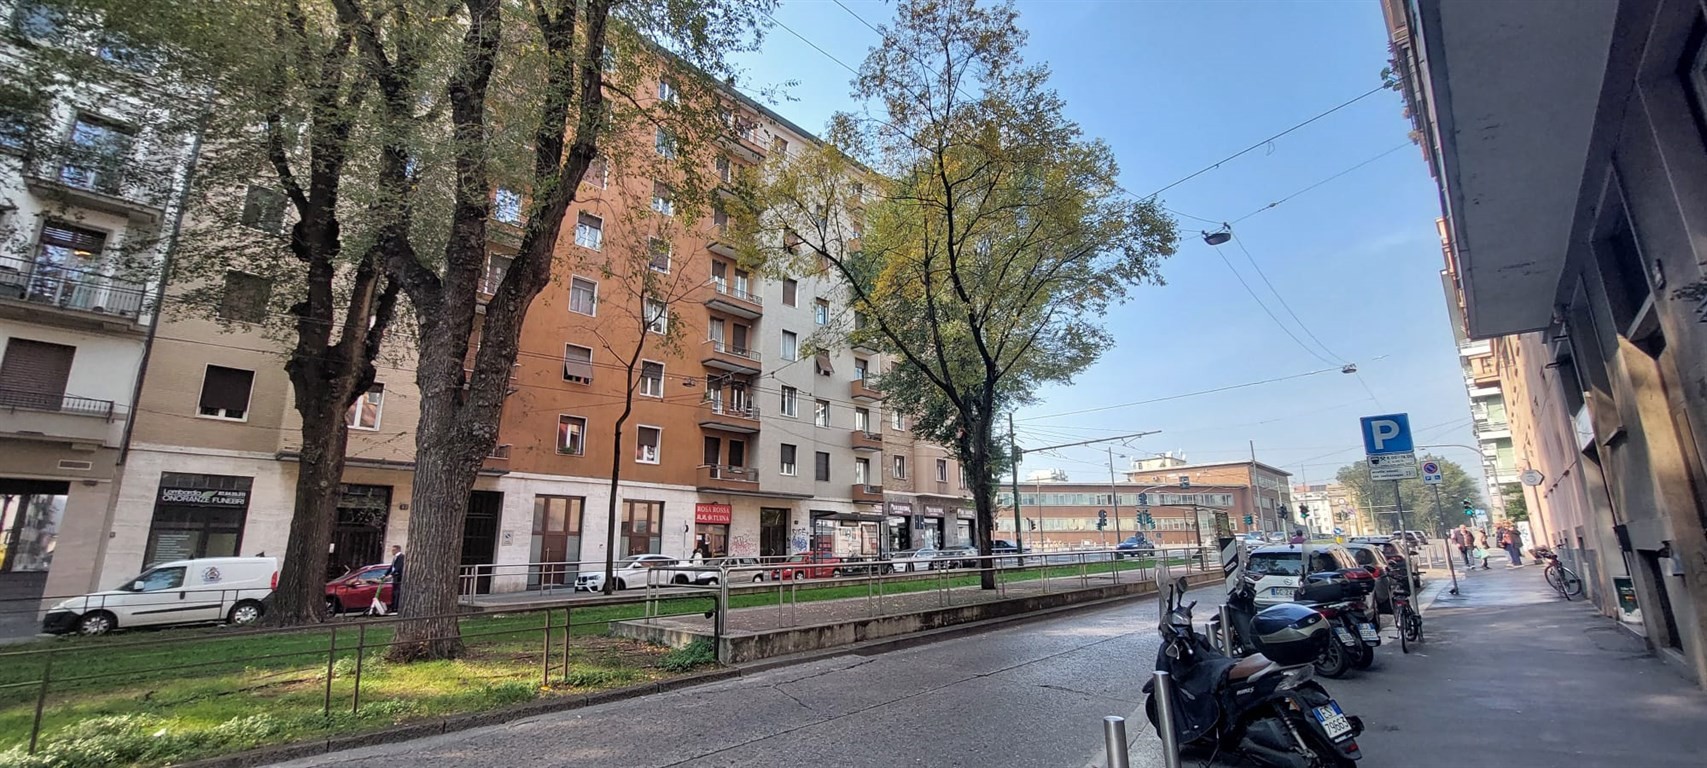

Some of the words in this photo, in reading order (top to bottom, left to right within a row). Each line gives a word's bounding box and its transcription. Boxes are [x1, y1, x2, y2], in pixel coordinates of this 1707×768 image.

[1371, 420, 1399, 450] P
[162, 495, 210, 503] ONORANZE
[212, 496, 245, 505] FUNEBRI
[713, 506, 730, 514] ROSSA
[1320, 706, 1333, 719] ES
